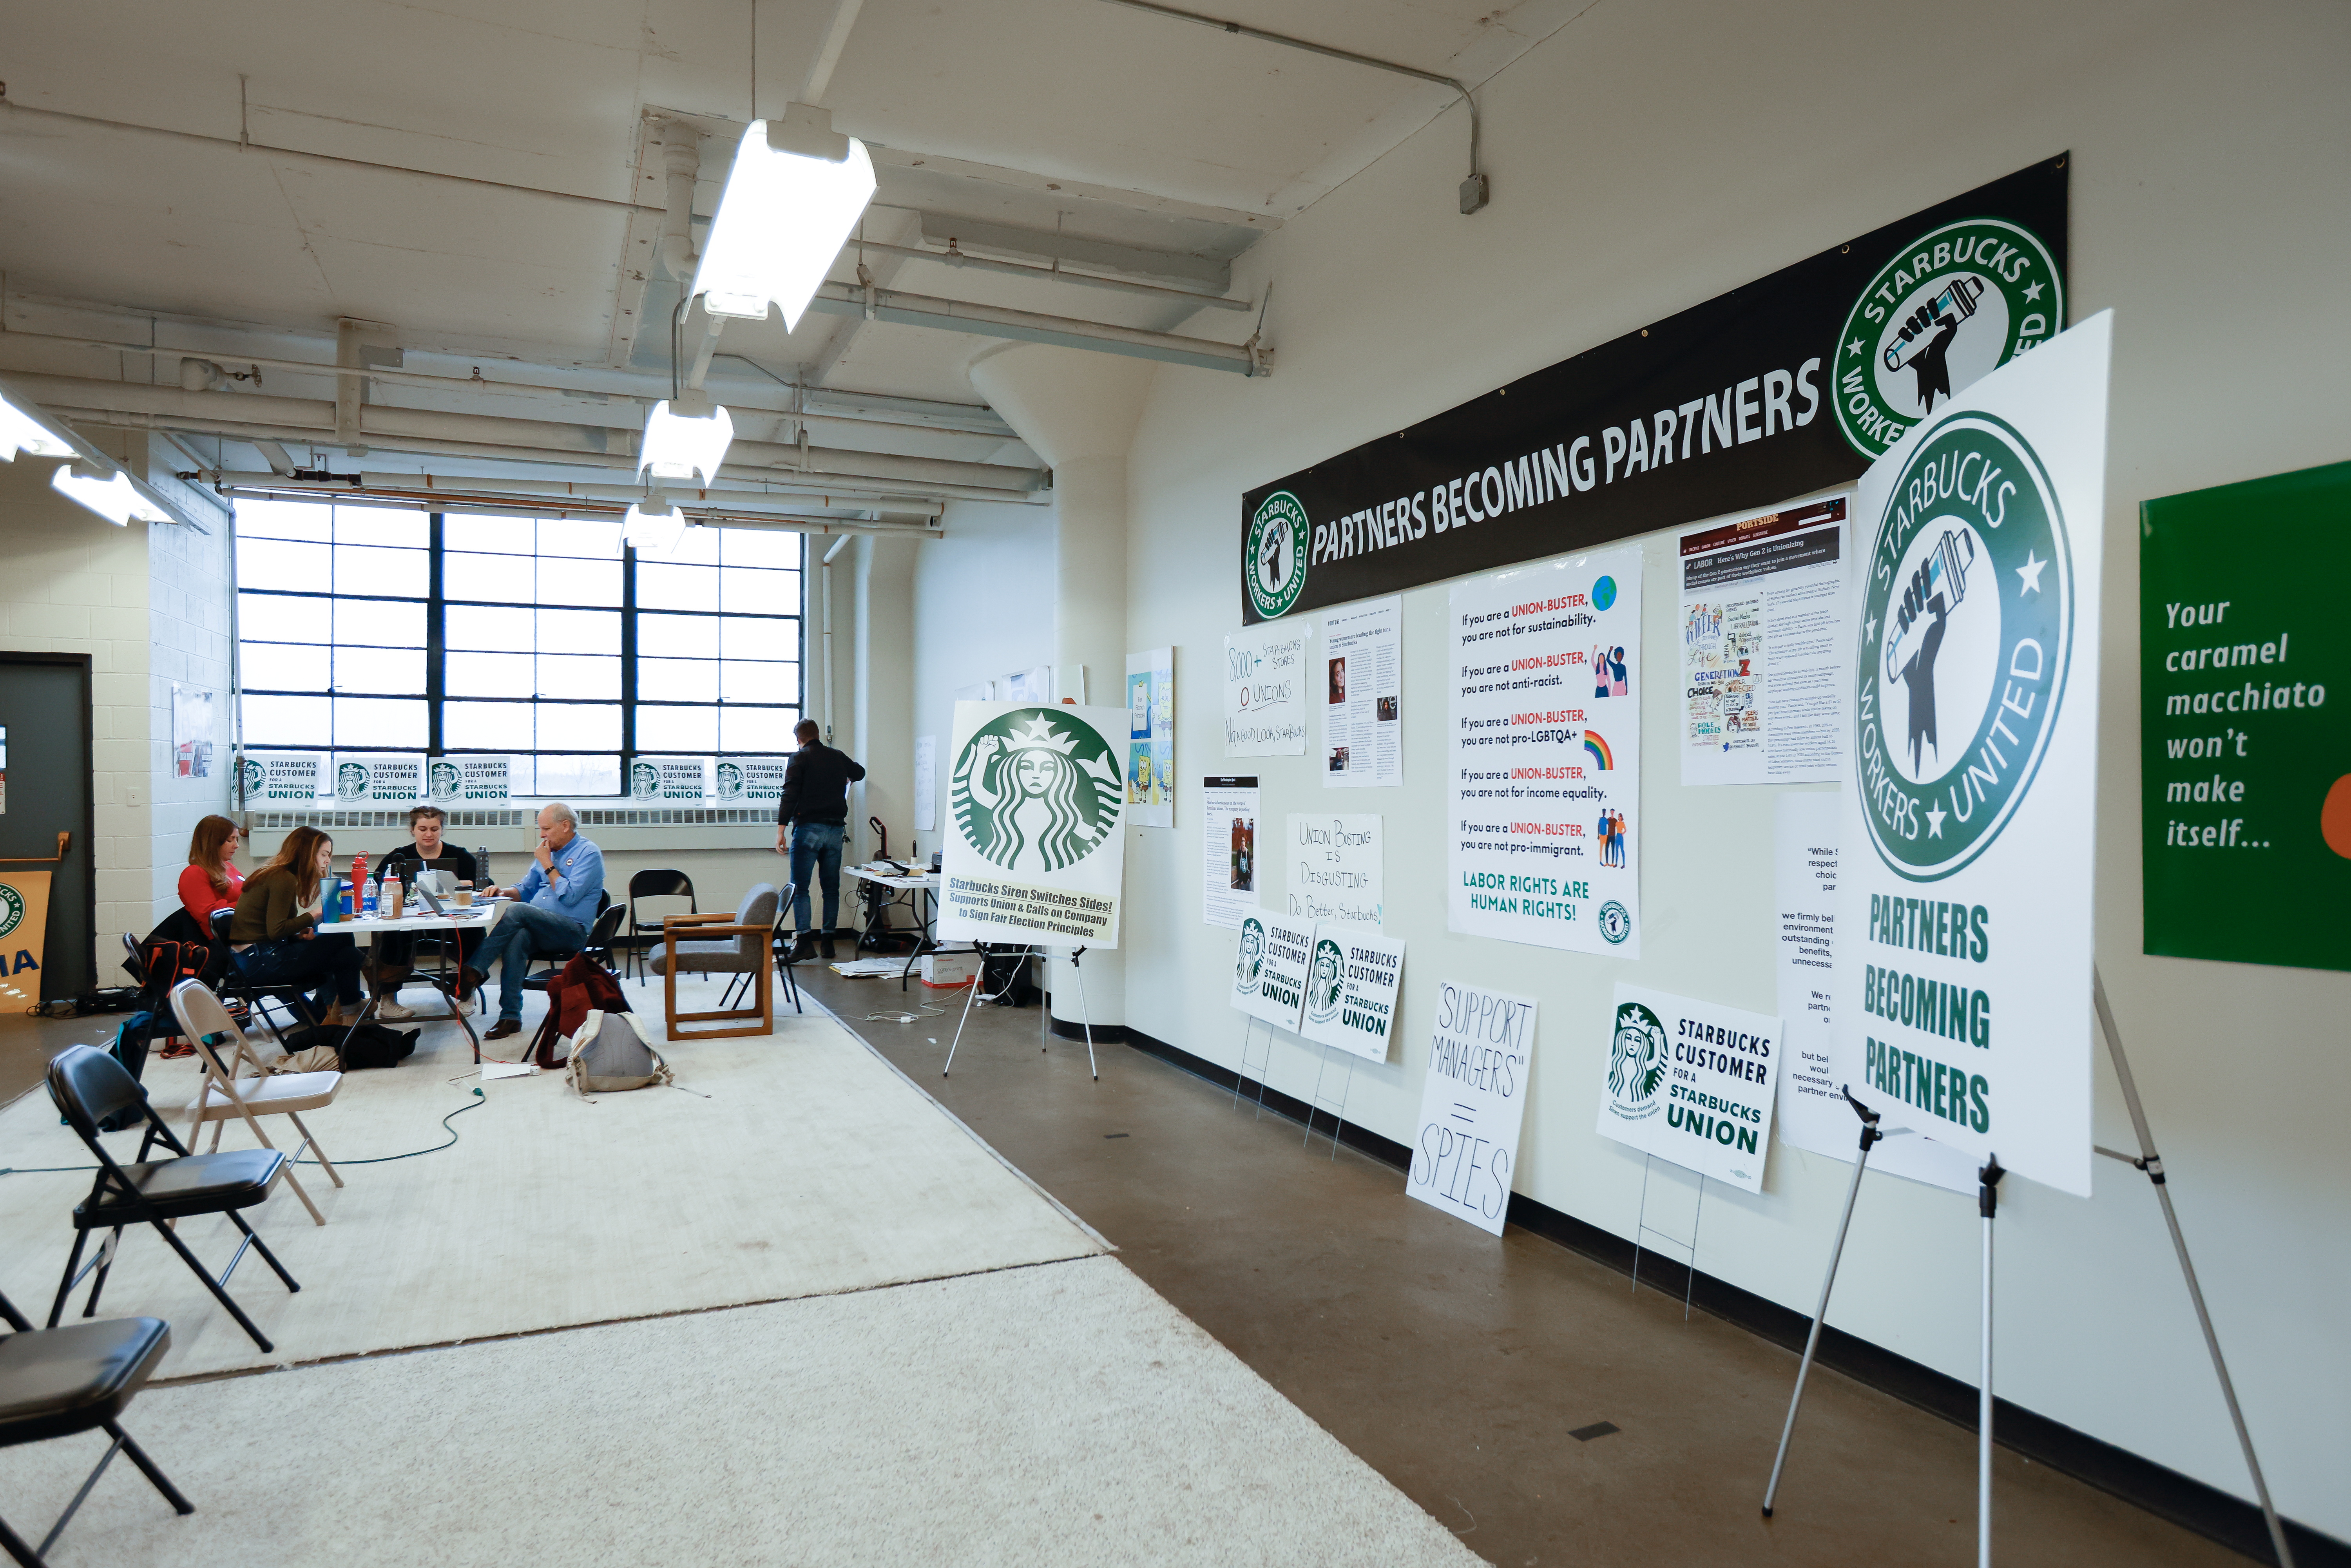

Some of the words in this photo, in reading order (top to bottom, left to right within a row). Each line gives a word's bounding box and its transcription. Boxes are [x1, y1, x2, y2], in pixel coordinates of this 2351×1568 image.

[1864, 236, 2030, 324] STARBUCKS
[1842, 366, 1910, 447] WORKE
[1312, 491, 1427, 566] PARTNERS
[1432, 436, 1596, 534] BECOMING
[1602, 357, 1821, 485] PARTNERS
[1255, 500, 1302, 538] STARBUCKS
[1737, 513, 1779, 531] PORTSIDE
[1877, 449, 2017, 592] STARBUCKS
[1694, 559, 1712, 569] LABOR
[1773, 540, 1804, 552] Unionizing
[1249, 560, 1275, 610] WORKERS
[1283, 545, 1304, 601] UNITED
[1462, 615, 1467, 626] If
[1469, 616, 1485, 628] you
[1487, 612, 1501, 621] are
[1512, 594, 1588, 617] UNION-BUSTER,
[2166, 600, 2230, 628] Your
[1462, 634, 1477, 646] you
[1480, 632, 1493, 640] are
[1496, 628, 1510, 638] not
[1512, 624, 1525, 635] for
[1528, 614, 1596, 633] sustainability.
[1263, 639, 1301, 657] STARBUCKS
[1272, 654, 1295, 670] STORES
[2166, 634, 2288, 672] caramel
[1462, 666, 1467, 677] If
[1469, 668, 1484, 679] you
[1487, 665, 1501, 674] are
[1512, 652, 1587, 671] UNION-BUSTER,
[1253, 680, 1291, 702] UNIONS
[1462, 686, 1477, 697] you
[1512, 675, 1562, 689] anti-racist.
[2166, 682, 2326, 716] macchiato
[1462, 718, 1467, 728] If
[1469, 720, 1484, 731] you
[1487, 718, 1501, 727] are
[1511, 710, 1587, 725] UNION-BUSTER,
[1462, 737, 1476, 748] you
[1479, 736, 1492, 744] are
[1495, 734, 1509, 744] not
[1512, 730, 1577, 746] pro-LGBTQA+
[1858, 676, 1920, 841] WORKERS
[1948, 637, 2043, 823] UNITED
[2167, 729, 2248, 759] won’t
[1462, 769, 1467, 780] If
[1469, 771, 1484, 782] you
[1486, 771, 1500, 779] are
[1511, 767, 1586, 781] UNION-BUSTER,
[2166, 774, 2245, 803] make
[1461, 789, 1476, 800] you
[1478, 789, 1492, 797] are
[1495, 788, 1509, 797] not
[1511, 786, 1524, 798] for
[1527, 787, 1559, 798] income
[1563, 786, 1607, 802] equality.
[1300, 822, 1330, 845] UNION
[1334, 820, 1371, 847] BUSTING
[1461, 820, 1466, 831] If
[1469, 824, 1483, 834] you
[1511, 822, 1586, 838] UNION-BUSTER,
[2167, 819, 2270, 847] itself...
[1326, 850, 1340, 862] IS
[1461, 840, 1475, 851] you
[1494, 841, 1509, 851] not
[1511, 842, 1584, 857] pro-immigrant.
[1301, 862, 1368, 889] DISGUSTING
[1464, 871, 1505, 890] LABOR
[1510, 875, 1557, 895] RIGHTS
[1563, 880, 1589, 899] ARE
[949, 877, 999, 894] Starbucks
[1001, 885, 1028, 899] Siren
[1030, 889, 1077, 907] Switches
[1079, 897, 1113, 912] Sides!
[1471, 894, 1517, 914] HUMAN
[1523, 899, 1576, 921] RIGHTS!
[0, 910, 20, 933] NITED
[949, 893, 989, 907] Supports
[991, 898, 1016, 911] Union
[1026, 904, 1049, 916] Calls
[1064, 909, 1107, 926] Company
[959, 908, 967, 917] to
[969, 908, 989, 921] Sign
[991, 912, 1007, 923] Fair
[1009, 915, 1045, 929] Election
[1047, 921, 1094, 937] Principles
[1290, 893, 1301, 916] Do
[1306, 895, 1337, 920] Better,
[1339, 903, 1382, 925] Starbucks!
[1869, 893, 1989, 963] PARTNERS
[1350, 947, 1397, 968] STARBUCKS
[1348, 965, 1394, 987] CUSTOMER
[1345, 995, 1389, 1014] STARBUCKS
[1864, 964, 1990, 1049] BECOMING
[1342, 1009, 1386, 1036] UNION
[1678, 1018, 1771, 1057] STARBUCKS
[1674, 1067, 1688, 1081] FOR
[1690, 1072, 1696, 1083] A
[1675, 1043, 1767, 1085] CUSTOMER
[1866, 1036, 1989, 1134] PARTNERS
[1451, 1103, 1476, 1123] =
[1609, 1105, 1620, 1116] Siren
[1621, 1111, 1638, 1121] support
[1648, 1106, 1661, 1118] union
[1612, 1099, 1636, 1113] Customers
[1637, 1100, 1656, 1112] demand
[1670, 1084, 1761, 1124] STARBUCKS
[1667, 1103, 1758, 1155] UNION
[1414, 1123, 1507, 1219] SPIES
